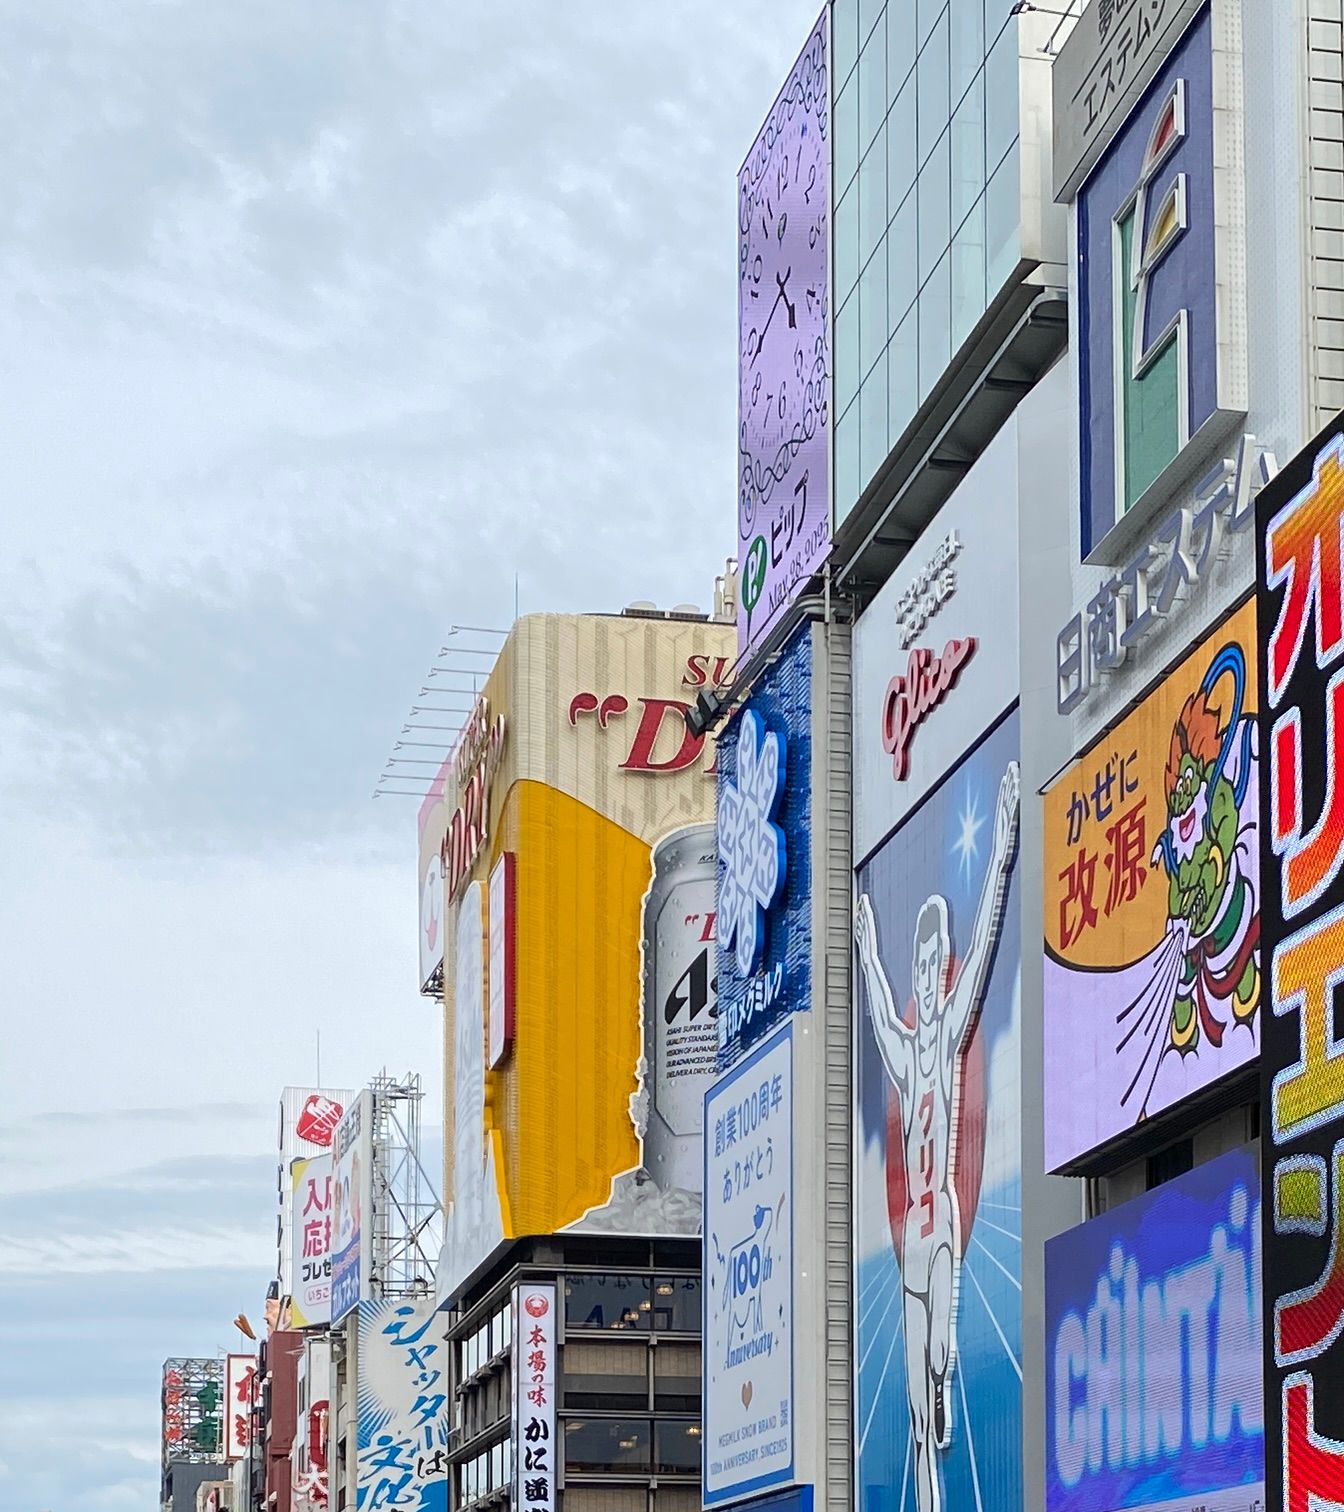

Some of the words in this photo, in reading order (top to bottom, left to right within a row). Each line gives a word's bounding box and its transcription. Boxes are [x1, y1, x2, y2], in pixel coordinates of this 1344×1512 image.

[771, 468, 809, 570] ピップ
[1056, 433, 1277, 716] 日商エステム
[881, 635, 980, 782] Glico
[1065, 748, 1141, 848] かぜに
[1058, 794, 1149, 953] 改源
[683, 1023, 702, 1033] SUPER
[714, 1074, 783, 1158] 創業100周年
[723, 1136, 775, 1204] ありがとう
[732, 1243, 774, 1300] 100th
[526, 1323, 549, 1408] 本場の味
[724, 1331, 774, 1372] Anniversary
[758, 1415, 777, 1434] BRAND
